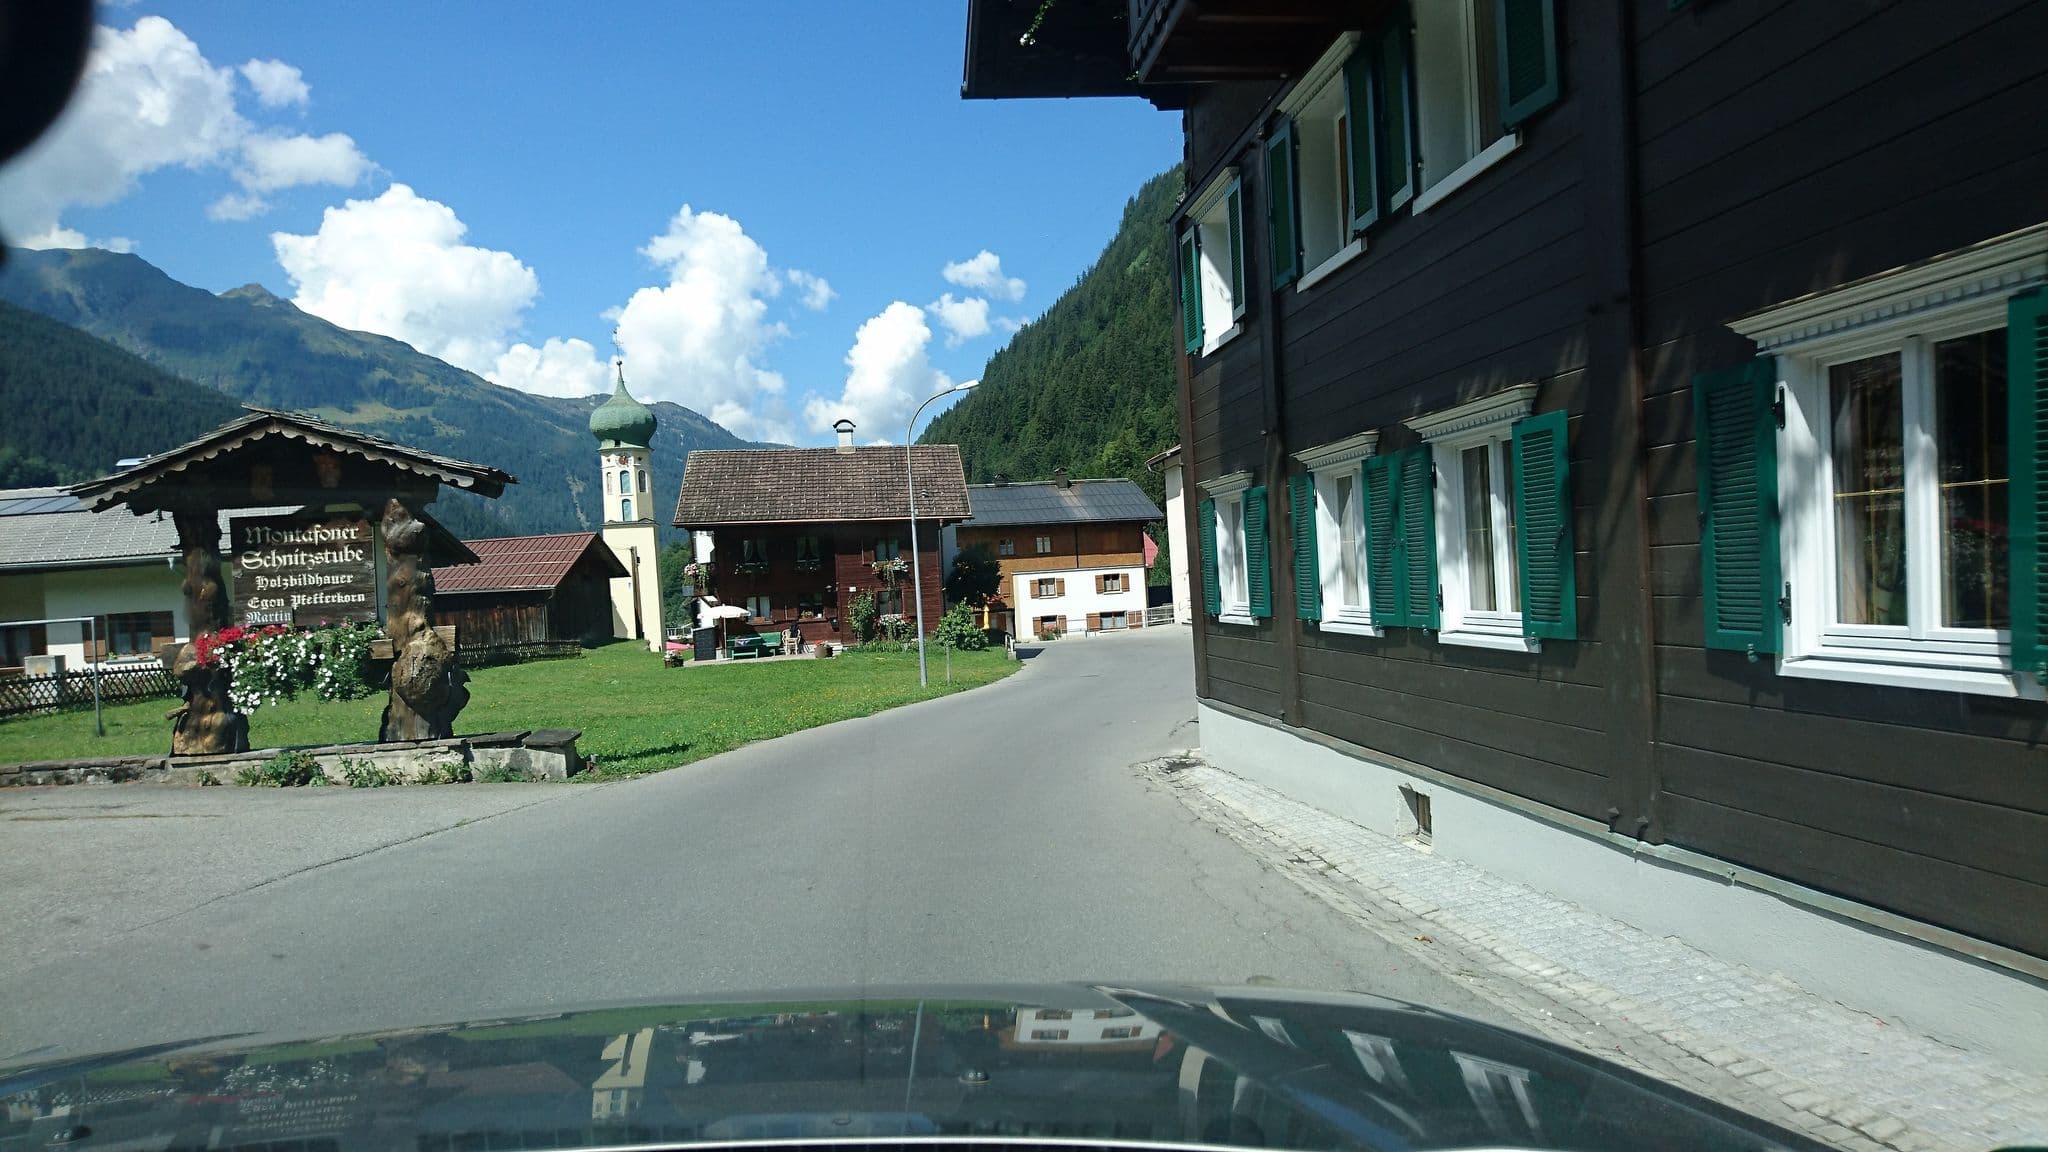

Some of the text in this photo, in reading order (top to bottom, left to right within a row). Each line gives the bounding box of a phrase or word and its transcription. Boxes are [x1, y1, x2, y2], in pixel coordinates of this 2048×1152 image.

[245, 524, 359, 546] Montafoner
[241, 544, 364, 571] Schnitzstube
[255, 573, 354, 591] Holzbildhauer
[247, 592, 365, 610] Egon Pfefferkorn
[245, 610, 291, 623] Martin
